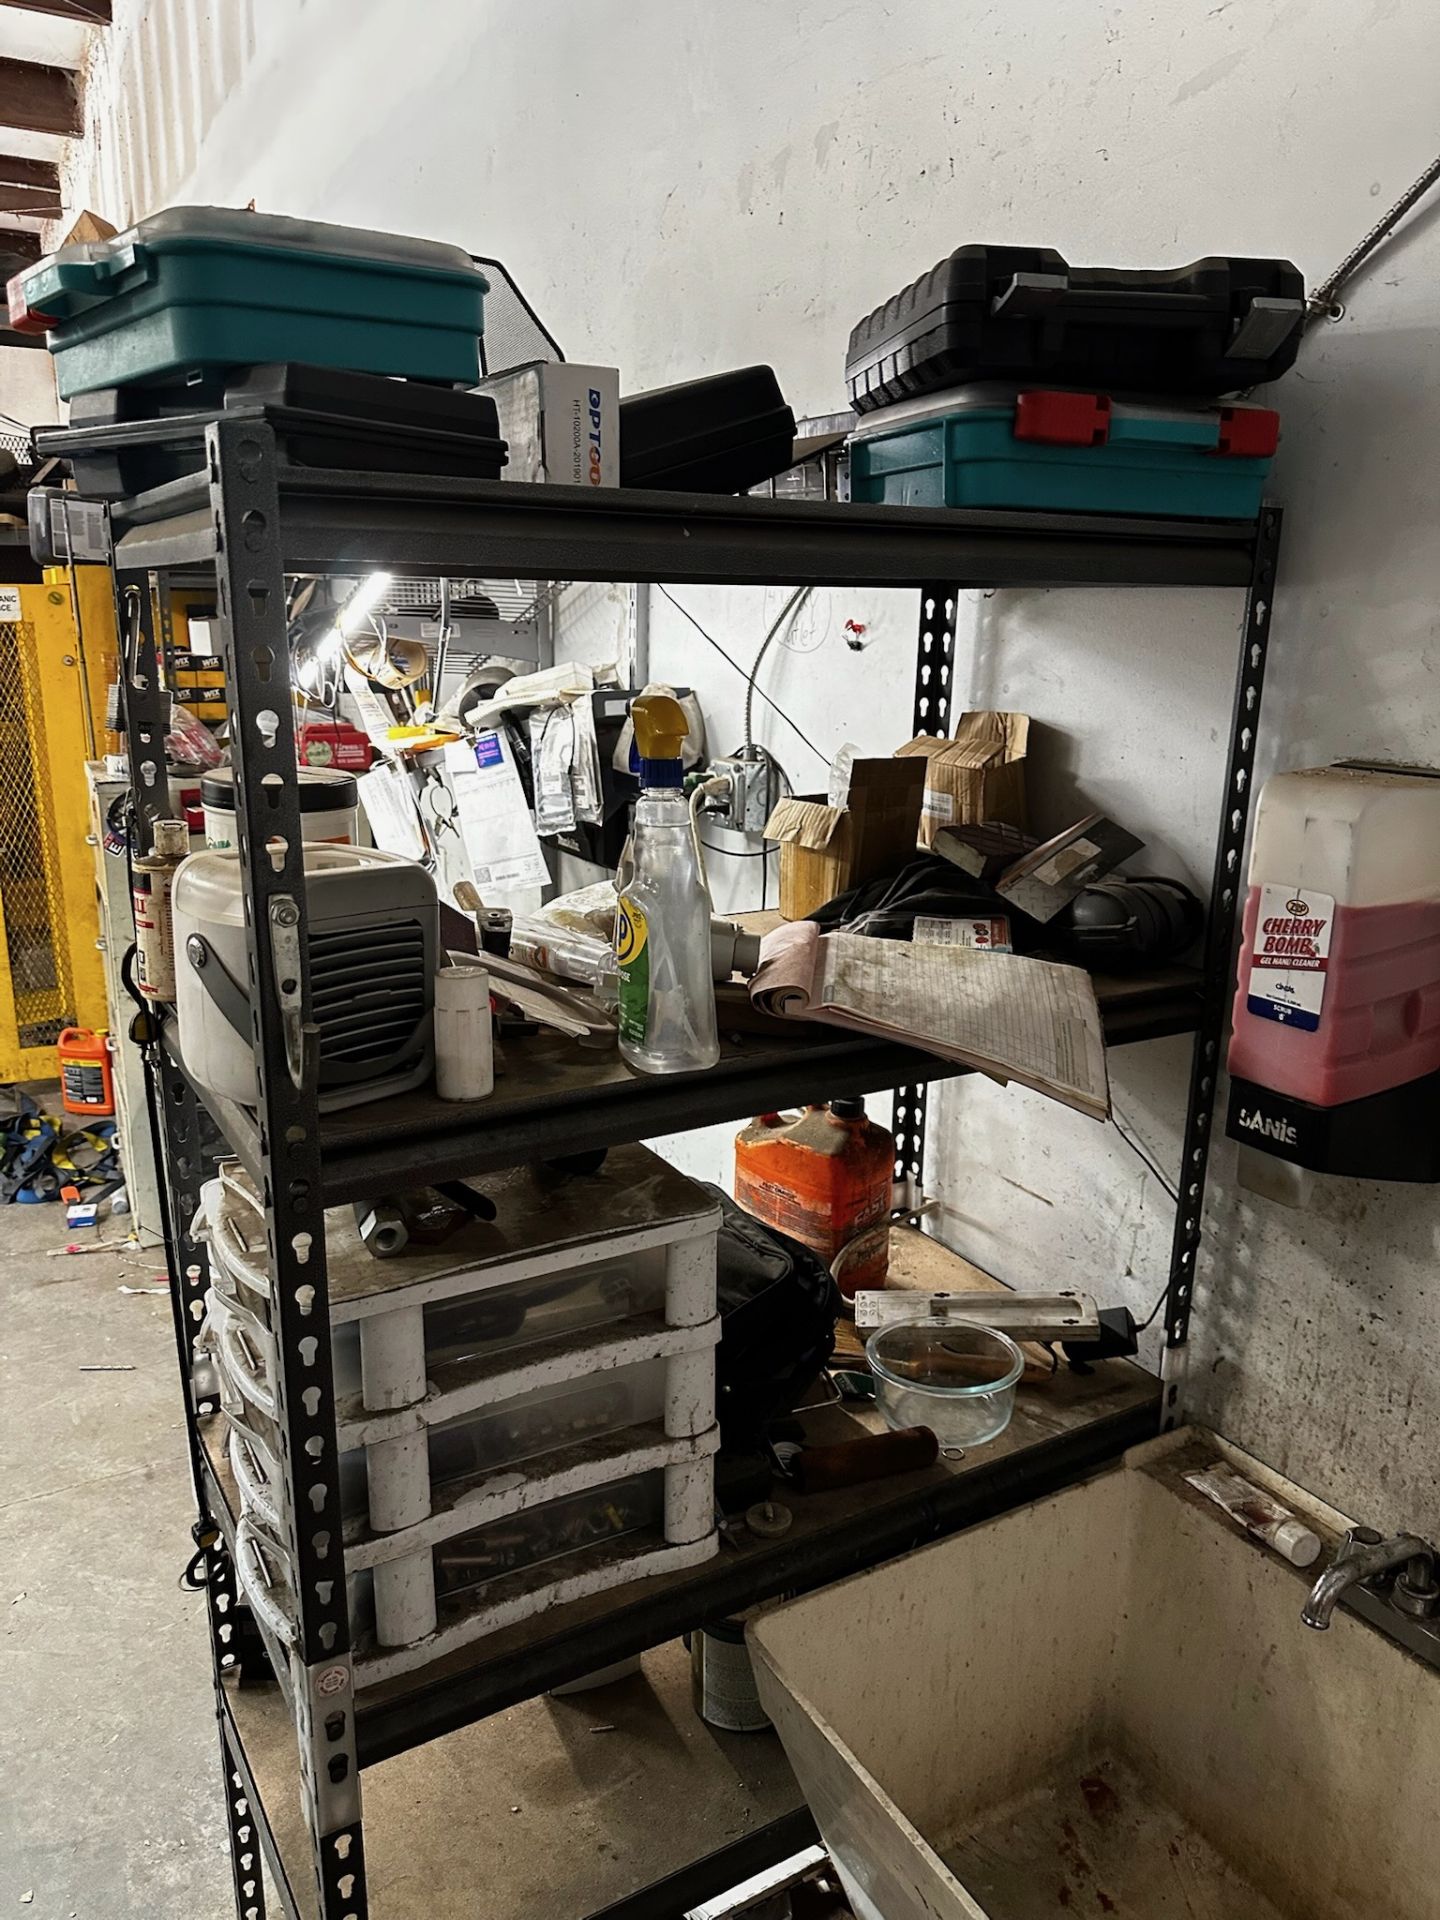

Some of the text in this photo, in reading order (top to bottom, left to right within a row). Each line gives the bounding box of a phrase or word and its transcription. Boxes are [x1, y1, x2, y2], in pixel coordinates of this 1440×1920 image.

[201, 656, 219, 669] WIX
[203, 688, 221, 699] WIX
[1262, 916, 1327, 937] CHERRY
[1263, 936, 1314, 955] BOMB
[1260, 956, 1320, 968] GEL HAND CLEANER
